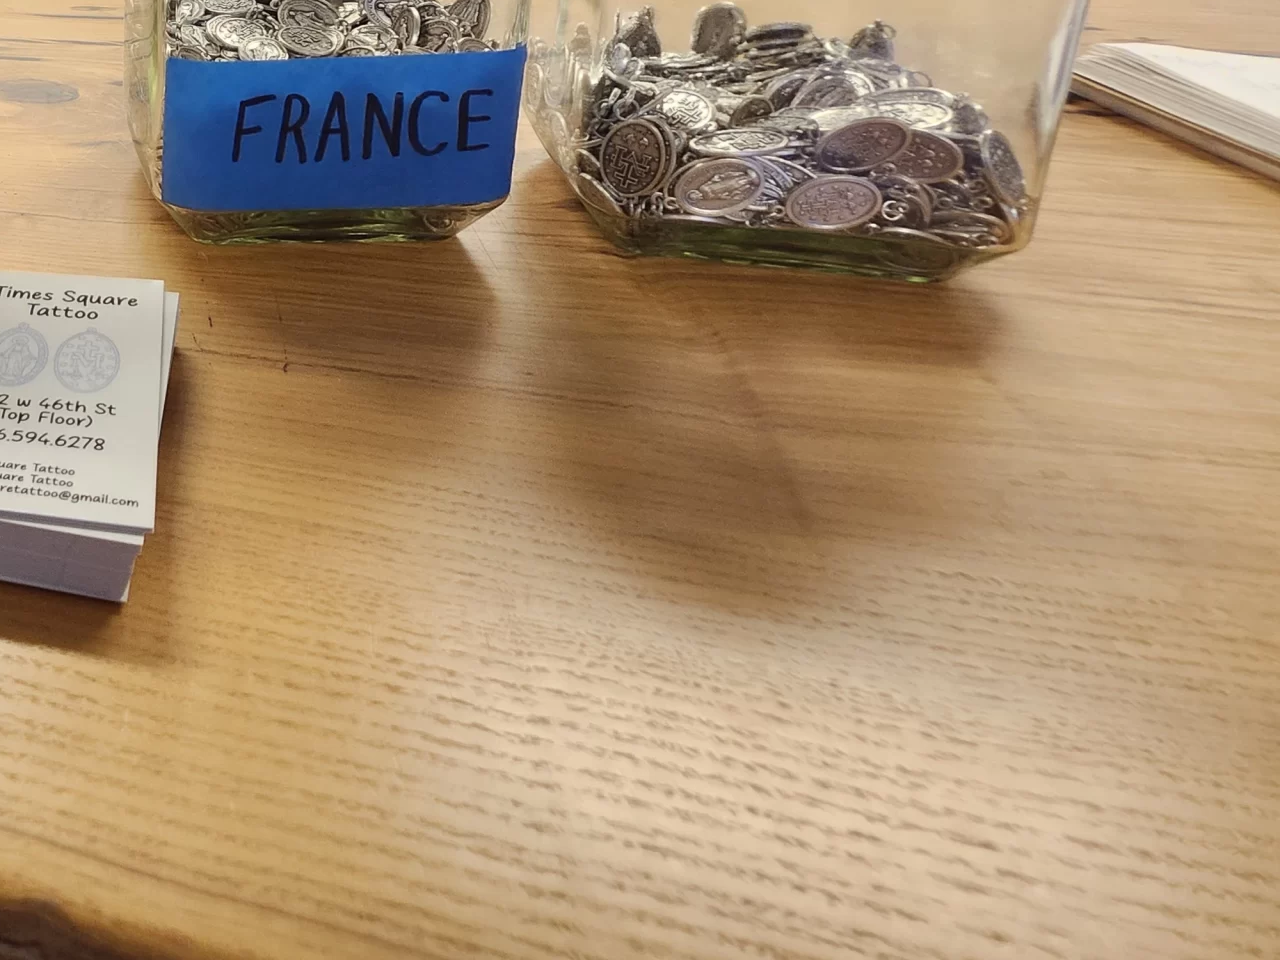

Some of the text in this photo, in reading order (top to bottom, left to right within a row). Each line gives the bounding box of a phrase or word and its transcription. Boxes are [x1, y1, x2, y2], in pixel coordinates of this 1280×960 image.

[231, 88, 495, 165] FRANCE
[62, 290, 139, 307] Square
[27, 302, 99, 320] Tattoo
[38, 397, 87, 413] 46th
[94, 402, 117, 416] St
[38, 411, 93, 428] Floor)
[33, 462, 76, 476] Tattoo
[30, 473, 74, 488] Tattoo
